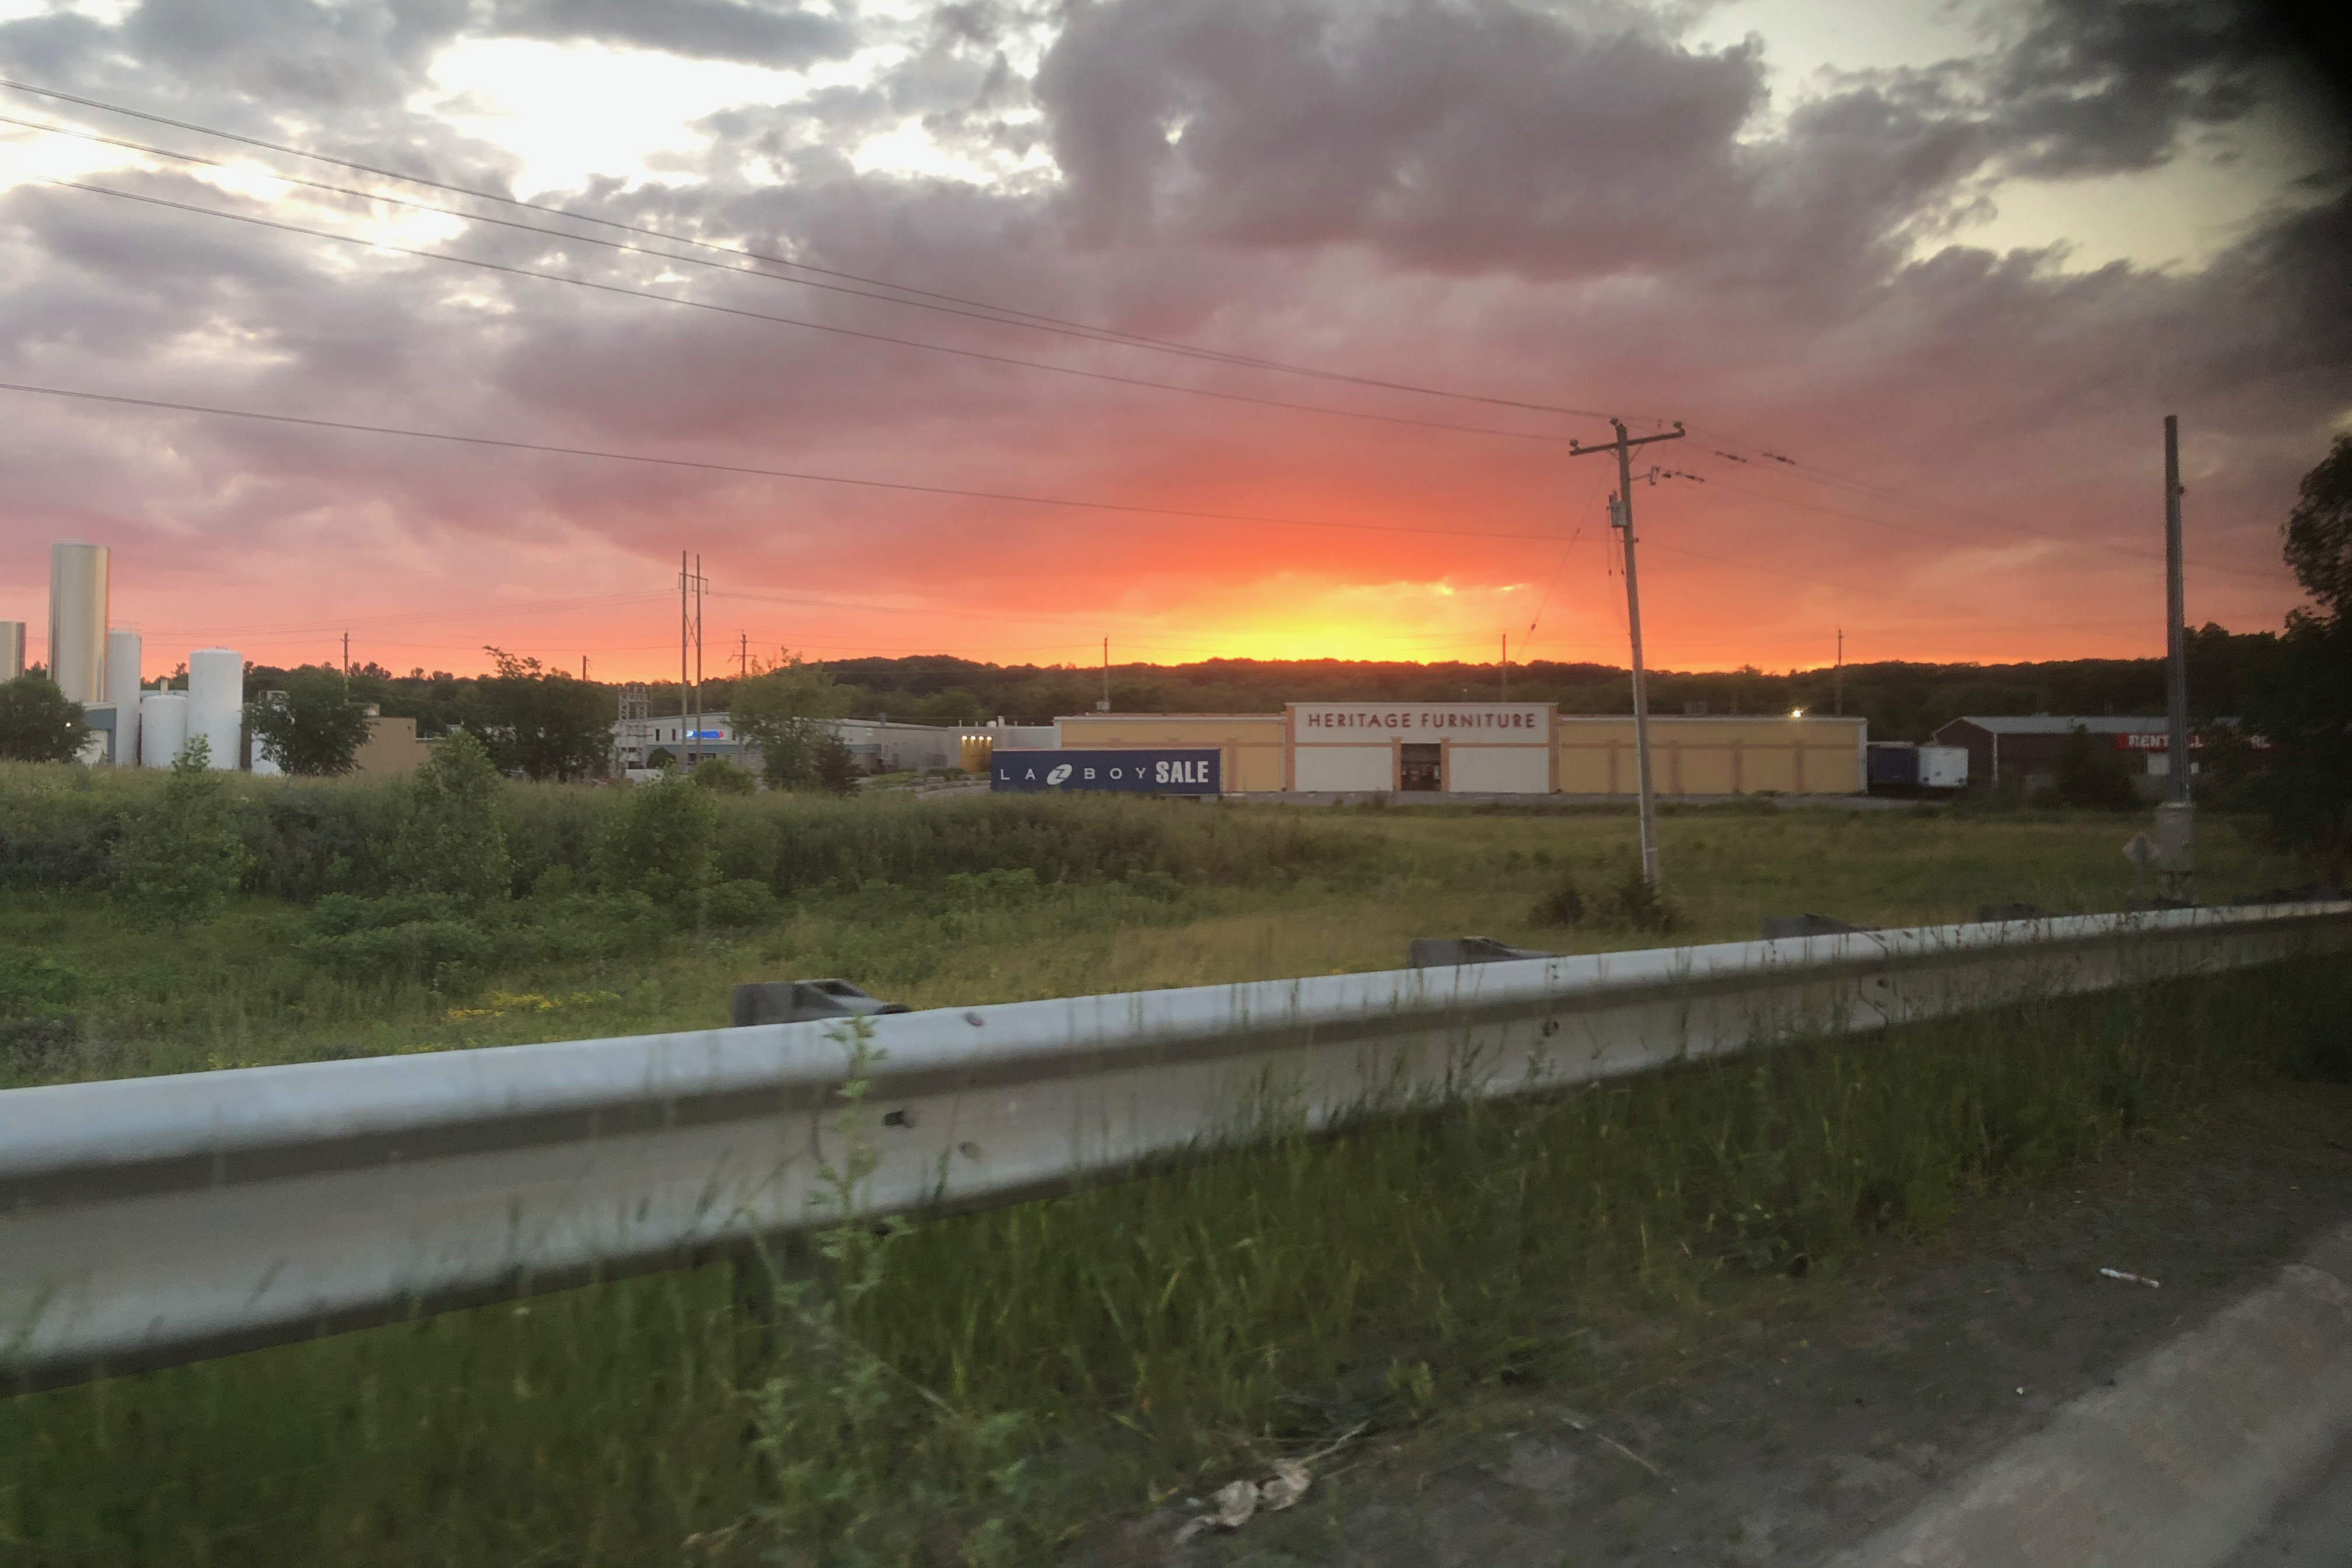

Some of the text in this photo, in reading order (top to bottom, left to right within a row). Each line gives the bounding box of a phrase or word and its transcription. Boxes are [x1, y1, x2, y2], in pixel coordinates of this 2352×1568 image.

[1308, 712, 1535, 728] HERITAGE FURNITURE
[1155, 761, 1209, 783] SALE
